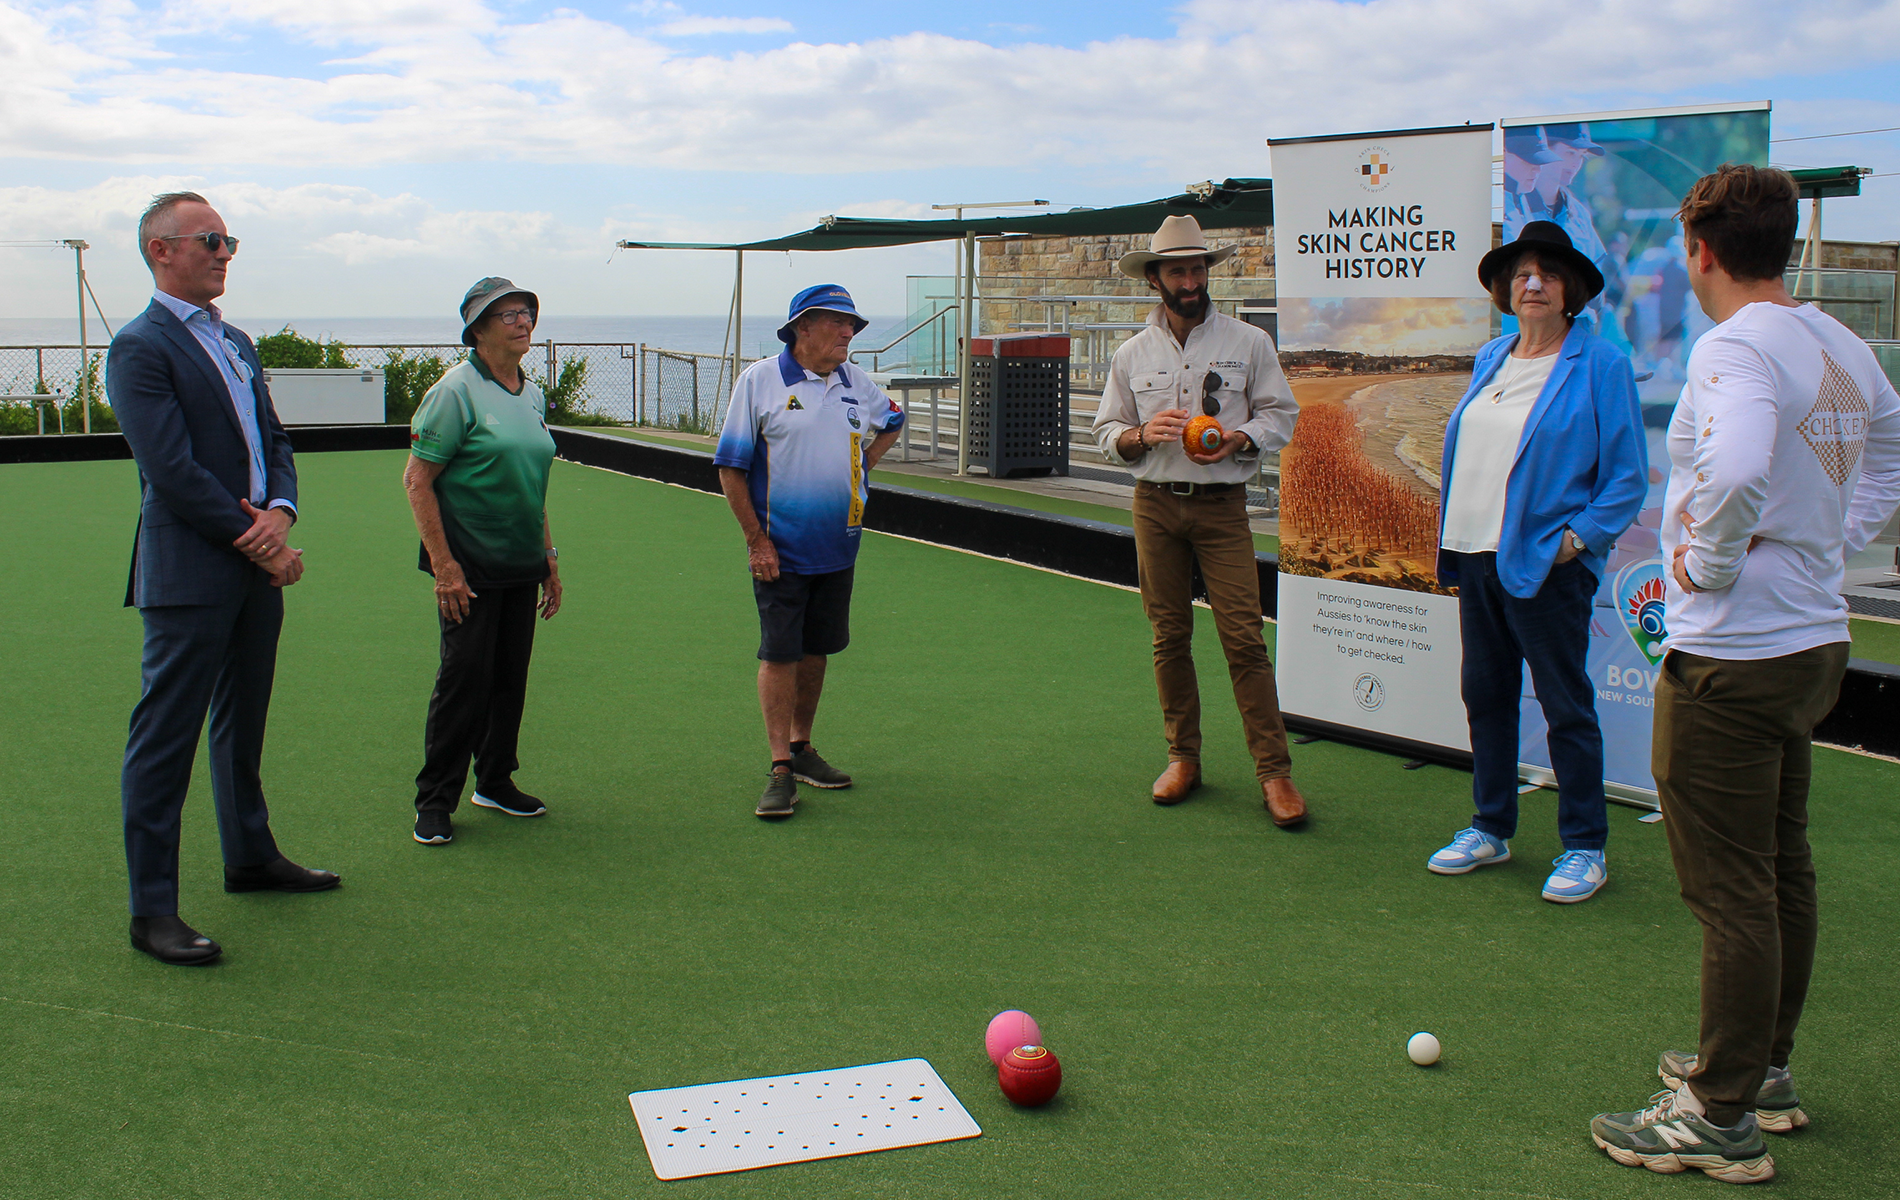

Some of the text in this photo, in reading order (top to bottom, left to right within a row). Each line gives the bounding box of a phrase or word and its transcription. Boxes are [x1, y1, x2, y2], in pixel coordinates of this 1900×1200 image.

[1372, 145, 1390, 157] CHECK
[1328, 205, 1423, 228] MAKING
[1297, 230, 1456, 254] SKIN CANCER
[1325, 257, 1426, 279] HISTORY
[1317, 591, 1428, 616] Improving awareness for
[1317, 608, 1352, 622] Aussies
[1353, 613, 1363, 623] to
[1392, 619, 1407, 631] the
[1408, 622, 1428, 633] skin
[1356, 630, 1374, 642] and
[1375, 634, 1404, 648] where
[1411, 640, 1432, 652] how
[1337, 644, 1406, 664] to get checked.
[1596, 689, 1623, 702] NEW
[1653, 1120, 1702, 1149] N
